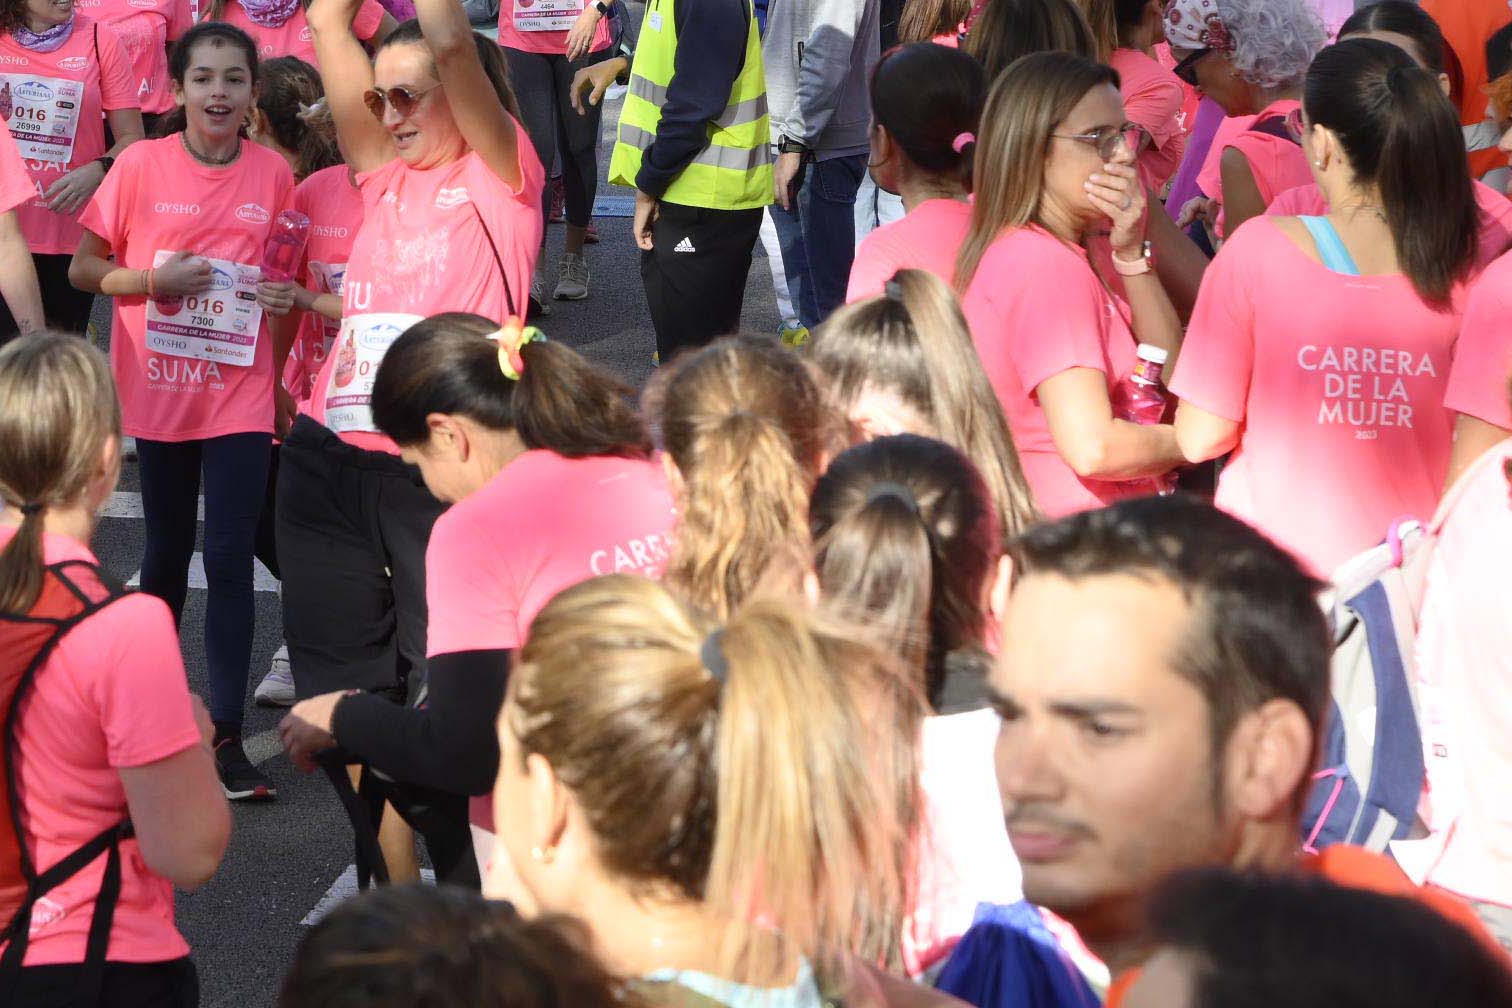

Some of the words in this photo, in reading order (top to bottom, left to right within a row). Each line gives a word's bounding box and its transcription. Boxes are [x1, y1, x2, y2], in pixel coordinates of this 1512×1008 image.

[14, 106, 46, 122] 016
[15, 121, 41, 132] 26999
[26, 133, 33, 141] LA
[37, 147, 65, 156] Santander
[154, 202, 200, 216] OYSHO
[187, 296, 225, 315] 016
[190, 315, 215, 327] 7300
[157, 323, 187, 335] CARRERA
[189, 326, 200, 335] DE
[200, 327, 208, 336] LA
[208, 329, 230, 340] MUJER
[153, 337, 187, 350] OYSHO
[213, 346, 248, 359] Santander
[1297, 344, 1437, 378] CARRERA
[147, 357, 222, 384] SUMA
[1324, 373, 1362, 399] DE
[1373, 376, 1410, 403] LA
[1318, 399, 1414, 429] MUJER
